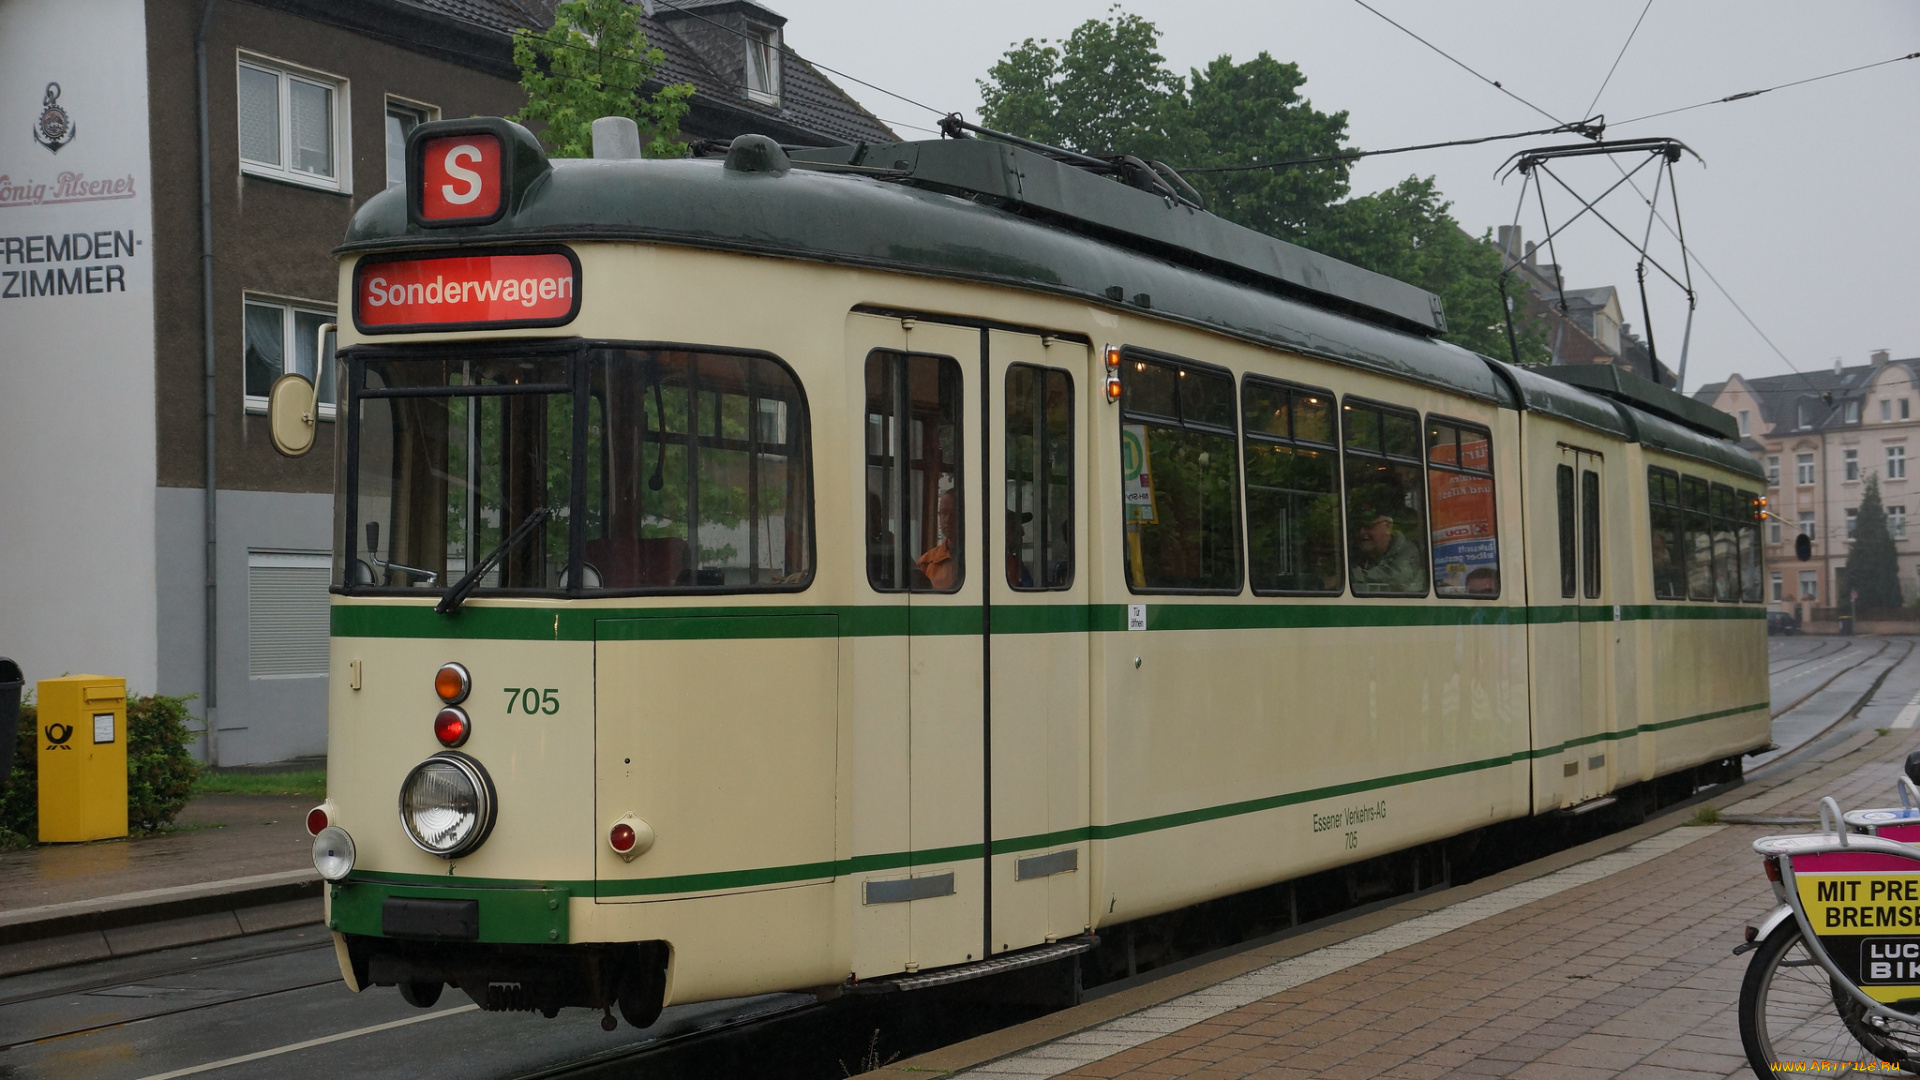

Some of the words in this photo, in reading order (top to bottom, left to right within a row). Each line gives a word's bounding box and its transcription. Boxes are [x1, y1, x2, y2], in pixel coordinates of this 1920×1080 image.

[441, 145, 482, 205] S
[2, 264, 126, 299] ZIMMER
[368, 275, 573, 308] Sonderwagen
[503, 687, 560, 715] 705
[1313, 813, 1342, 833] Essener
[1344, 800, 1386, 826] Verkehrs-AG
[1345, 831, 1358, 850] 705
[1818, 881, 1861, 902] MIT
[1871, 944, 1920, 959] LUC
